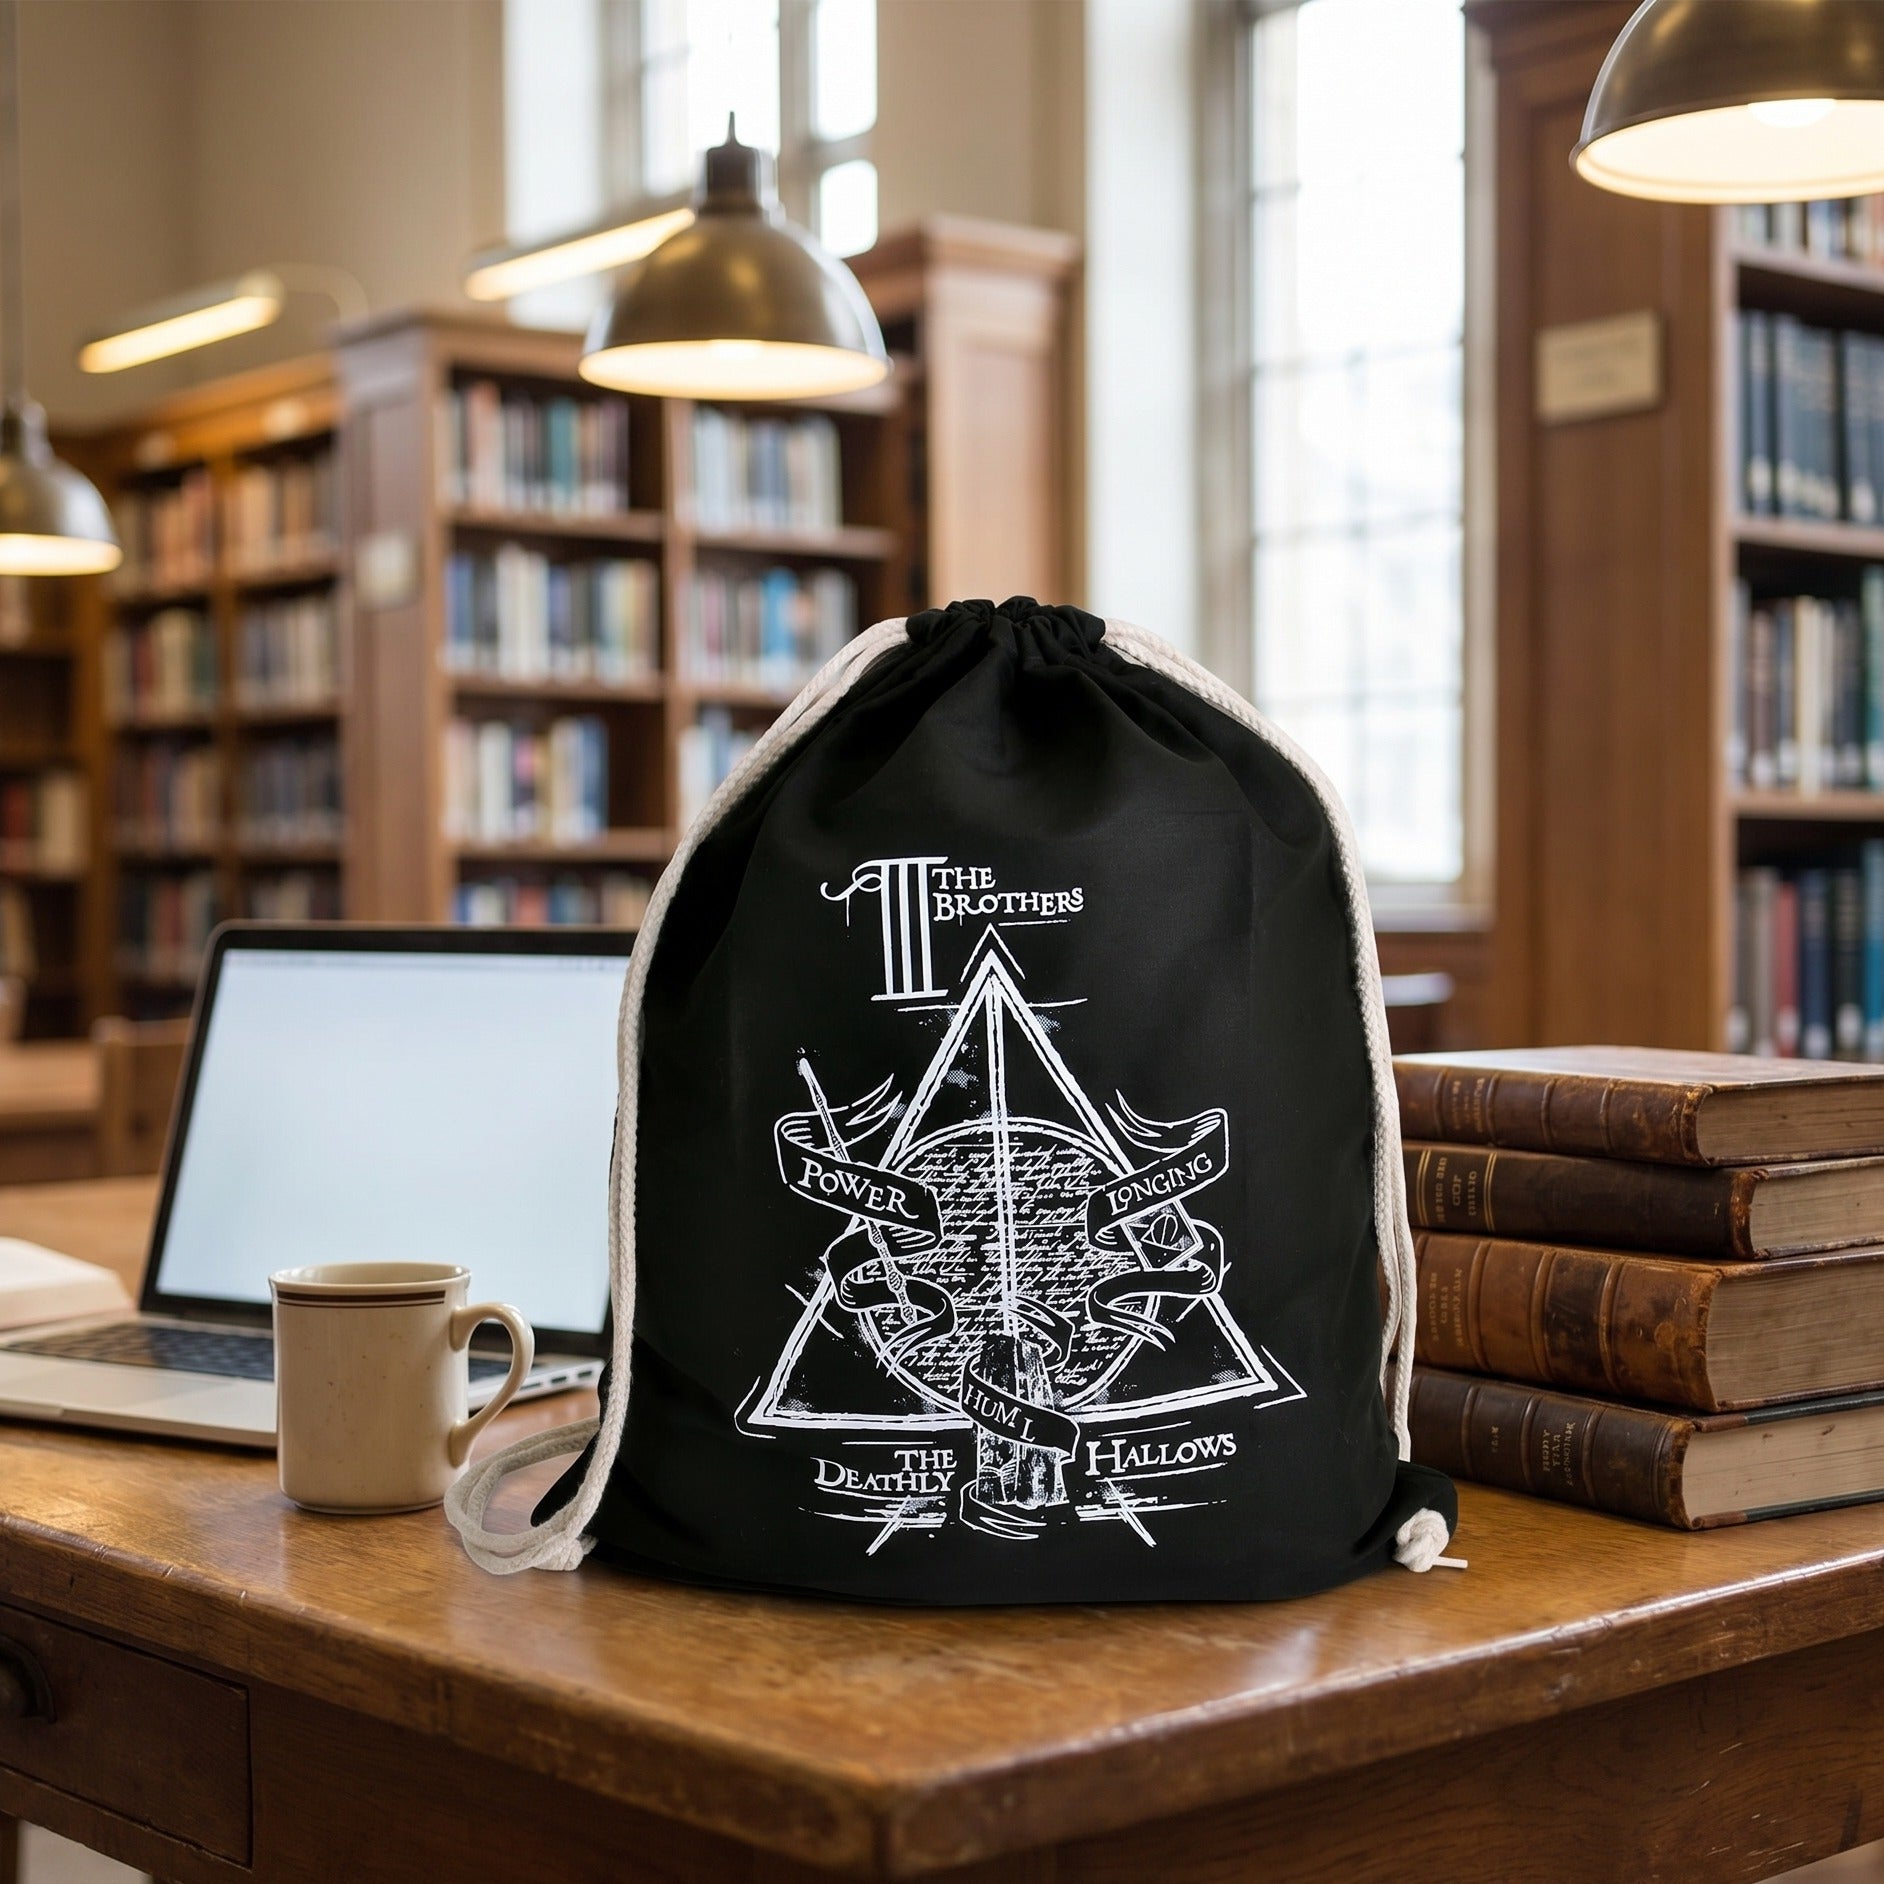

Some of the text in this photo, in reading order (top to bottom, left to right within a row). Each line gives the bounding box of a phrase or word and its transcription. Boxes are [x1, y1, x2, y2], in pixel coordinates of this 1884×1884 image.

[931, 867, 996, 890] THE
[933, 887, 1084, 922] BROTHERS
[799, 1157, 919, 1219] POWER
[1105, 1153, 1213, 1217] LONGING
[894, 1449, 957, 1472] THE
[1085, 1433, 1238, 1476] HALLOWS
[810, 1457, 957, 1492] DEATHLY
